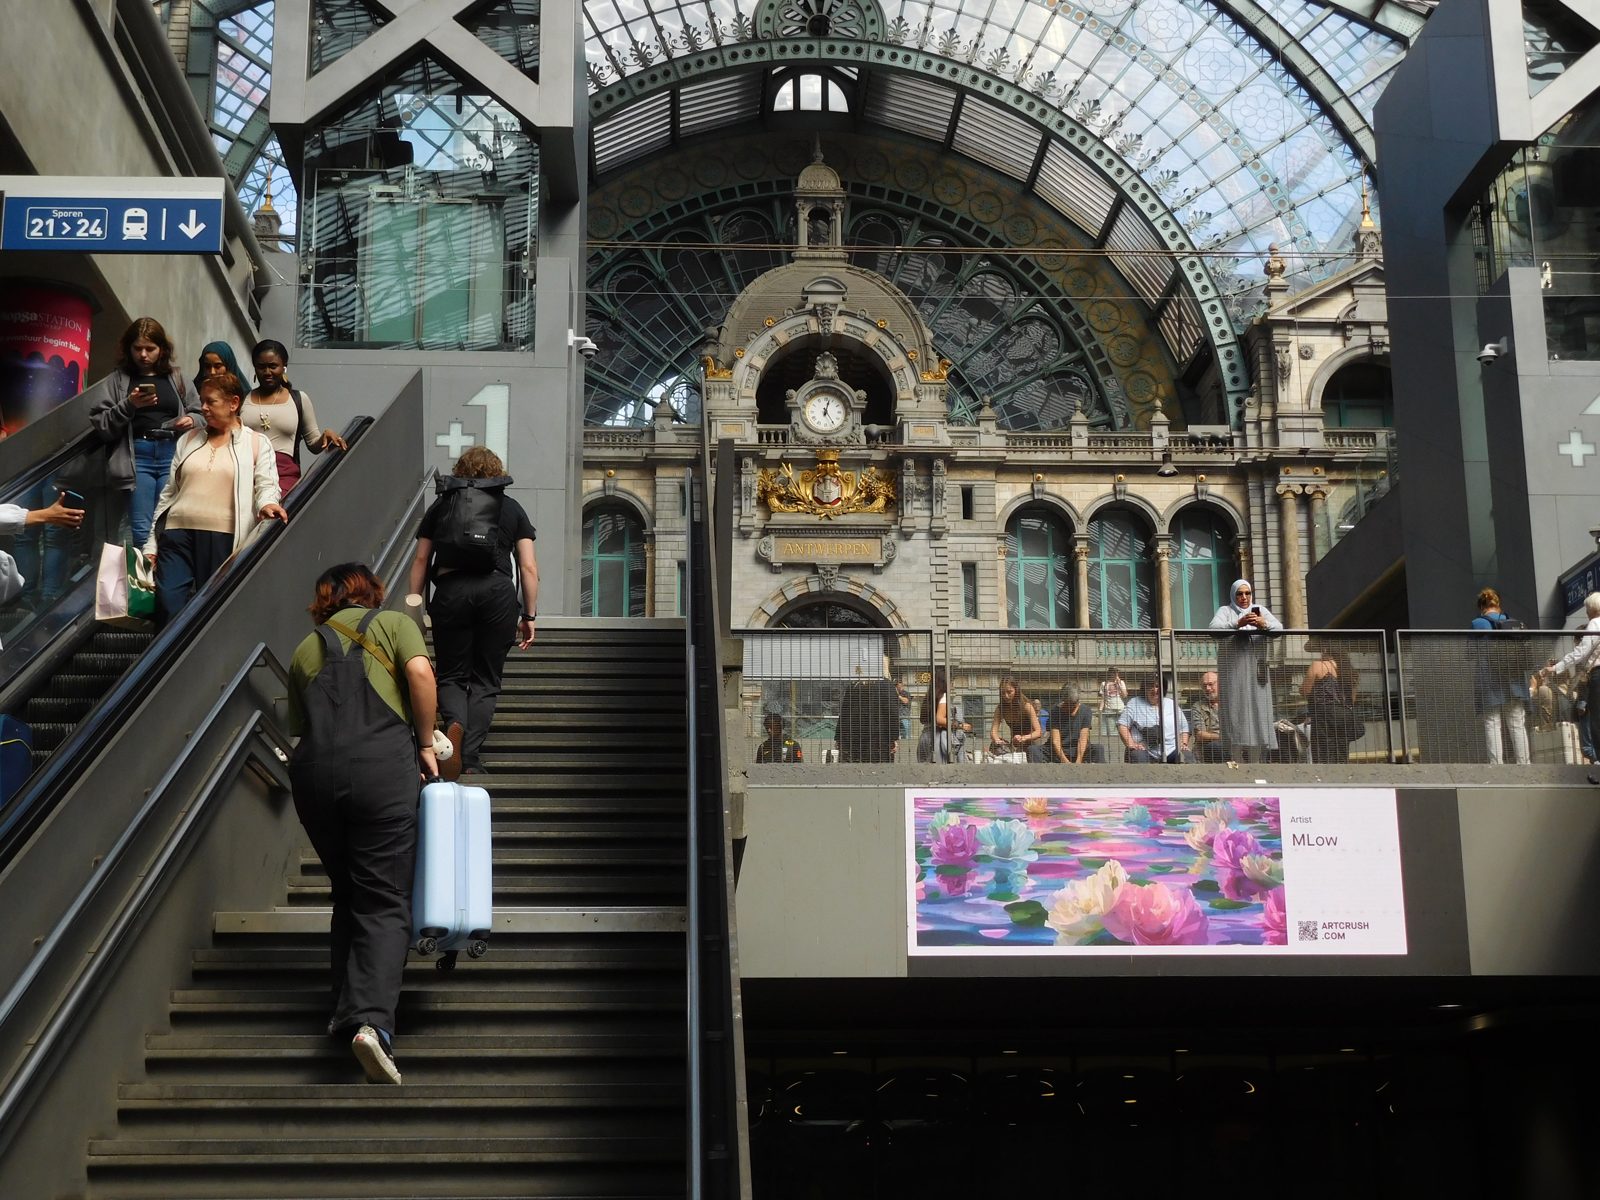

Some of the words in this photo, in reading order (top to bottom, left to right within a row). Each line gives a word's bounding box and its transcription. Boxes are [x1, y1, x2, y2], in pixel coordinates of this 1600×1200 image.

[52, 210, 83, 219] Sporen
[30, 218, 55, 237] 21
[76, 218, 103, 237] 24
[43, 335, 68, 348] begint
[69, 342, 81, 353] hier
[783, 543, 871, 556] ANTWERPEN
[1290, 816, 1312, 824] Artist
[1292, 833, 1338, 847] MLow
[1321, 921, 1370, 930] ARTCRUSH
[1321, 932, 1346, 940] .COM
